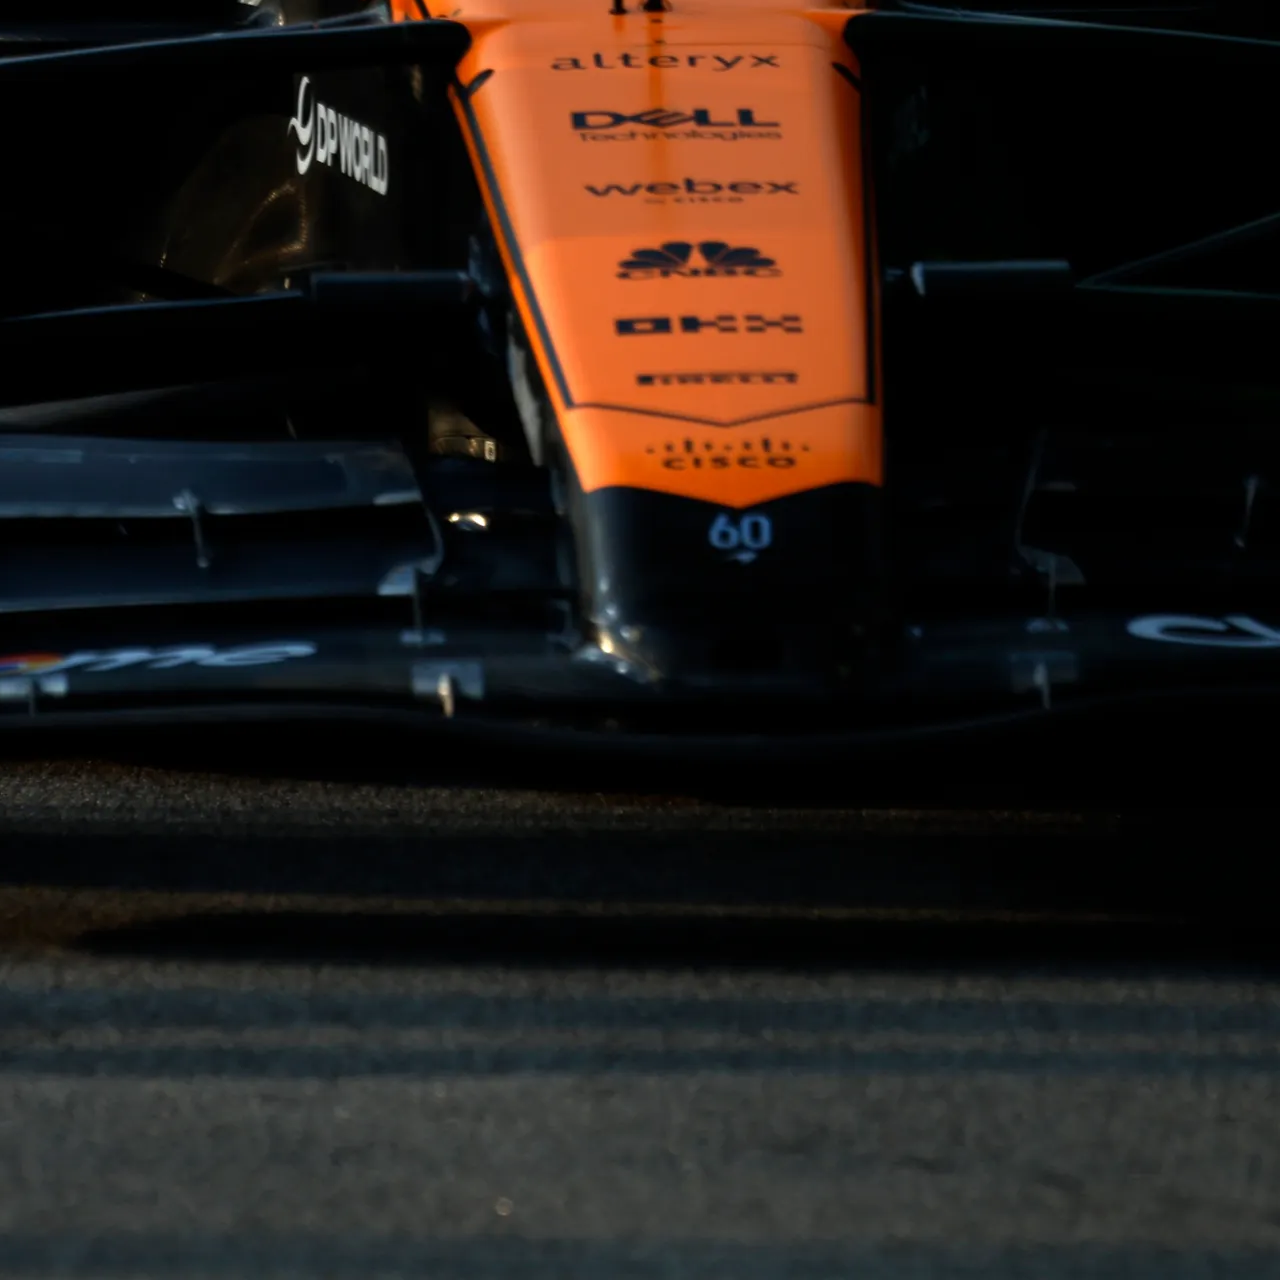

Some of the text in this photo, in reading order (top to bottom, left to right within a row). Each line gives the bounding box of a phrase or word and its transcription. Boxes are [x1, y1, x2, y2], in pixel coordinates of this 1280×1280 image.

[551, 52, 781, 72] alteryx
[571, 108, 781, 131] DELL
[316, 101, 389, 197] DP WORLD
[584, 177, 800, 198] webex
[616, 268, 783, 280] CNBC
[615, 315, 803, 336] OKX
[707, 511, 773, 550] 60
